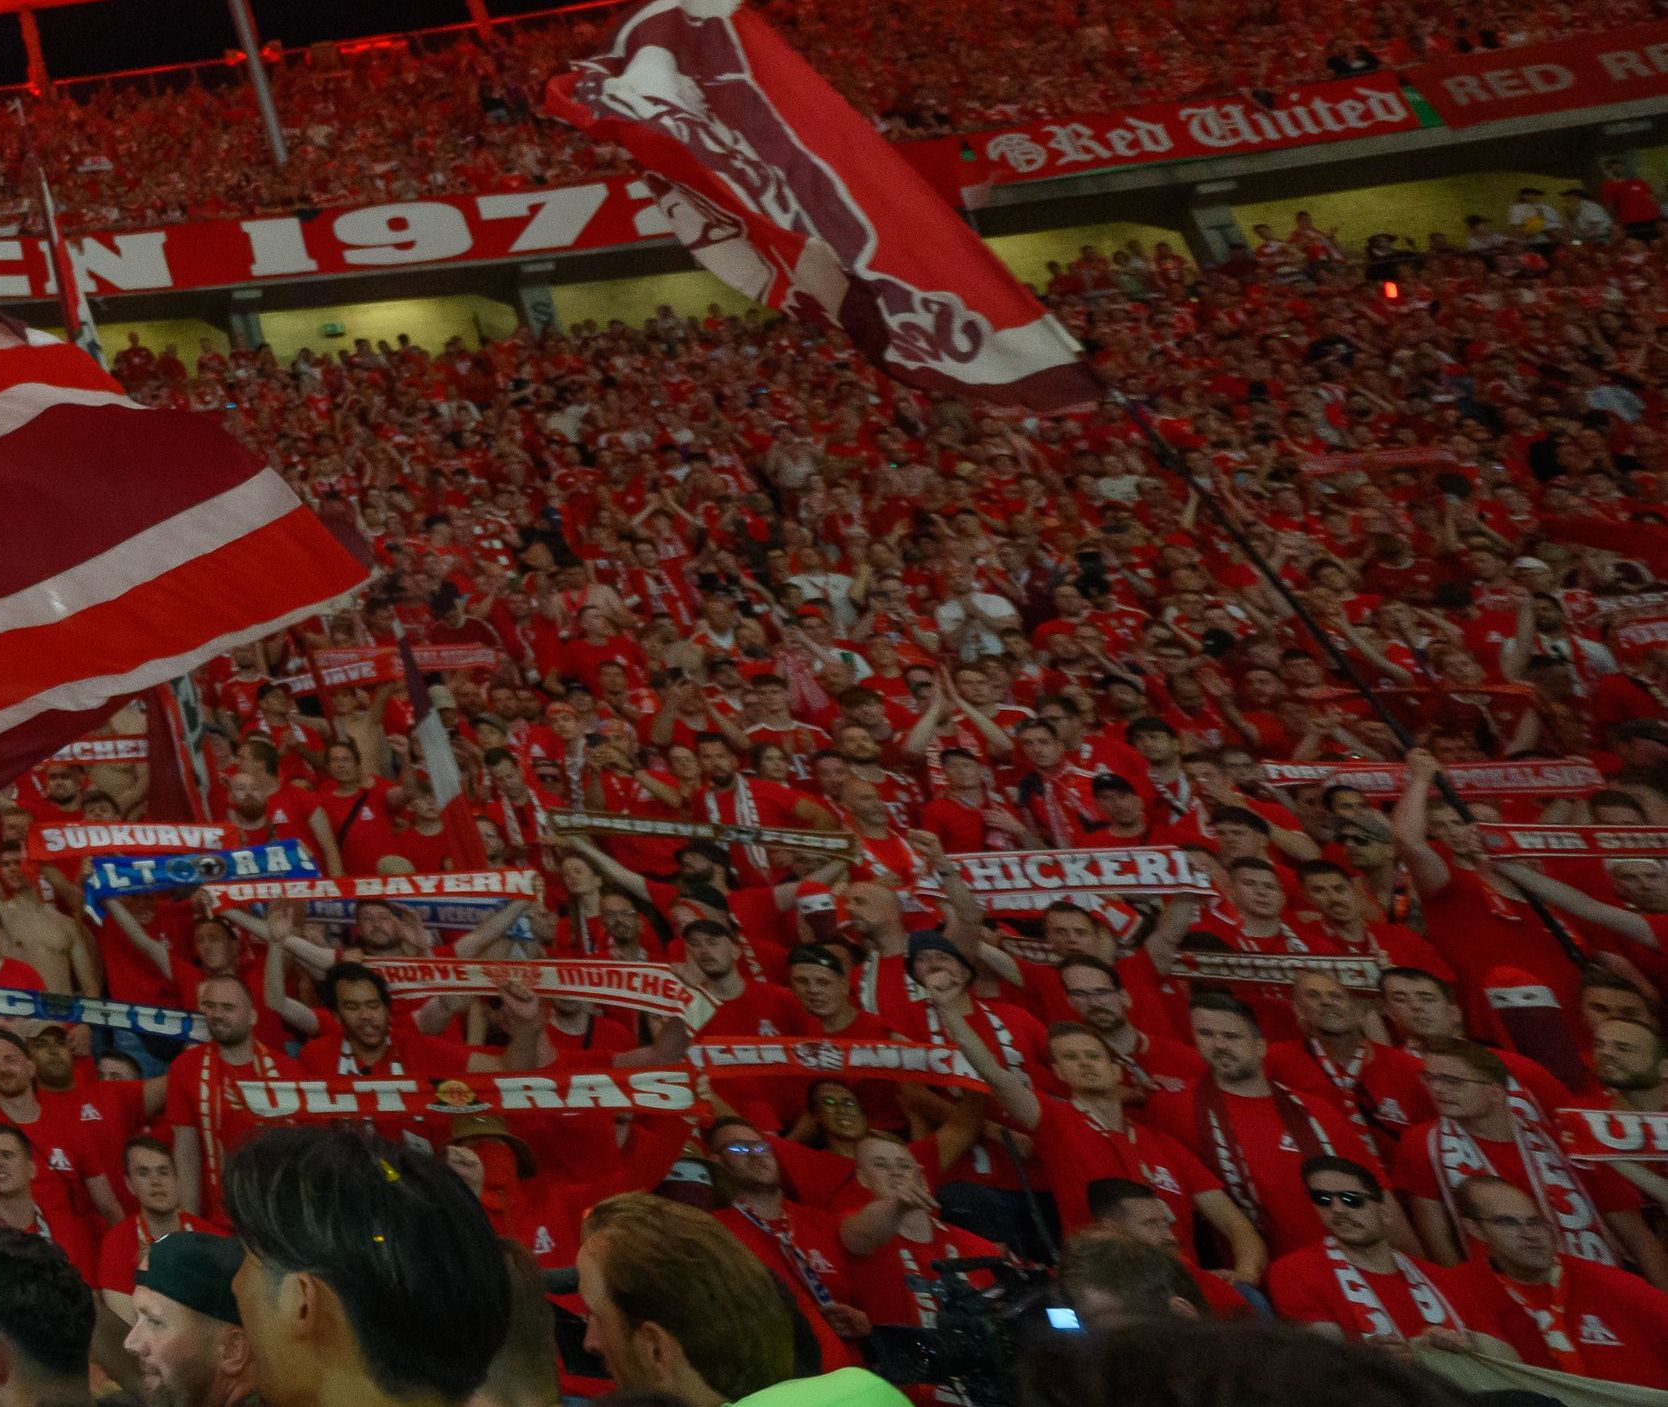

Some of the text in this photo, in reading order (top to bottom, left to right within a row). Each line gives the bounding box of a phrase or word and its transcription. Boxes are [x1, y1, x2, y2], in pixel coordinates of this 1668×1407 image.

[1442, 63, 1575, 105] RED
[1050, 87, 1411, 167] Red United
[41, 824, 224, 852] SÜDKURVE
[356, 868, 538, 896] BAYERN
[237, 1071, 697, 1119] ULT RAS
